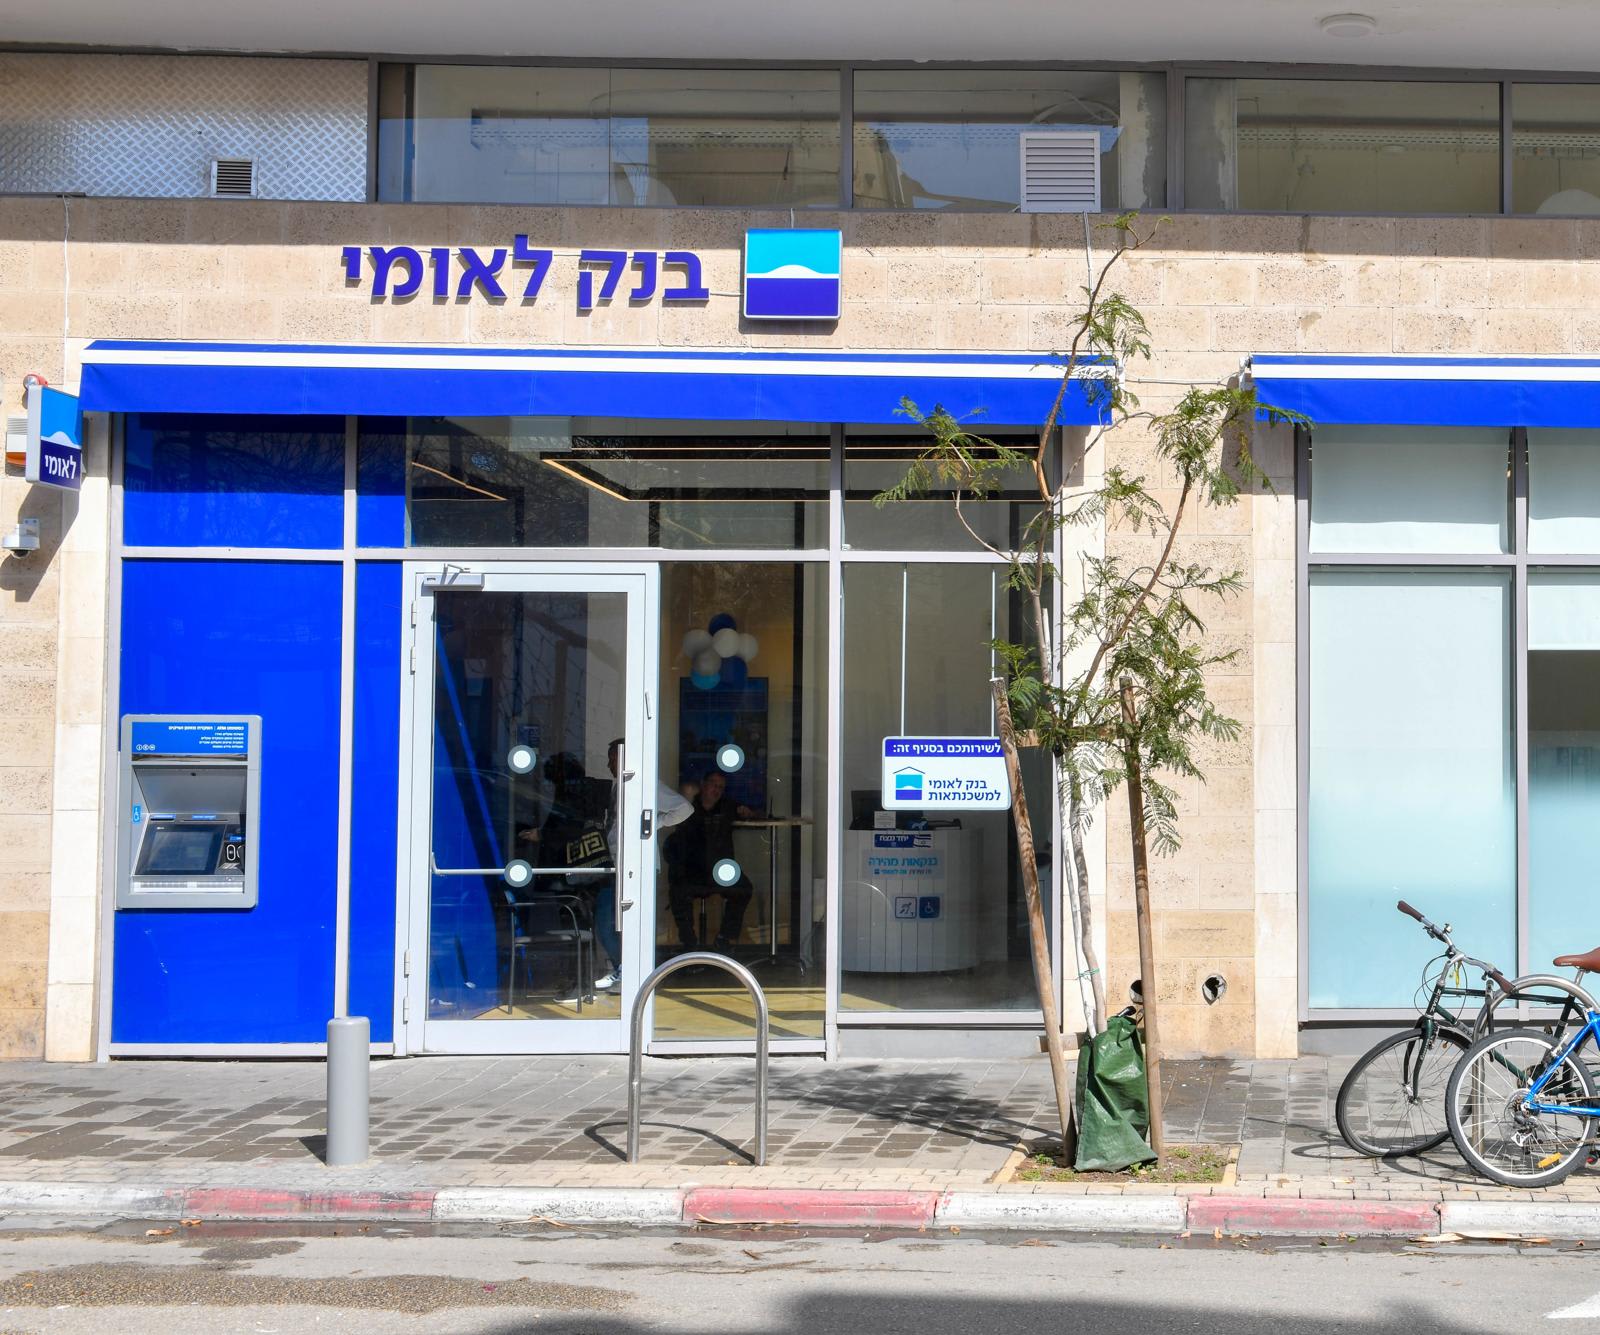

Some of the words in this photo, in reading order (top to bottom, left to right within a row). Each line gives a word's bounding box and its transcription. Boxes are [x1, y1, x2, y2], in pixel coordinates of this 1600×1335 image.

[342, 234, 553, 300] לאומי
[578, 249, 709, 309] בנק
[44, 454, 76, 479] לאומי
[893, 744, 909, 753] זה:
[912, 744, 944, 754] בסניף
[947, 743, 1001, 753] לשירותכם
[929, 778, 962, 789] לאומי
[966, 780, 987, 791] בנק
[928, 790, 1001, 801] למשכנתאות
[868, 857, 898, 867] מהירה
